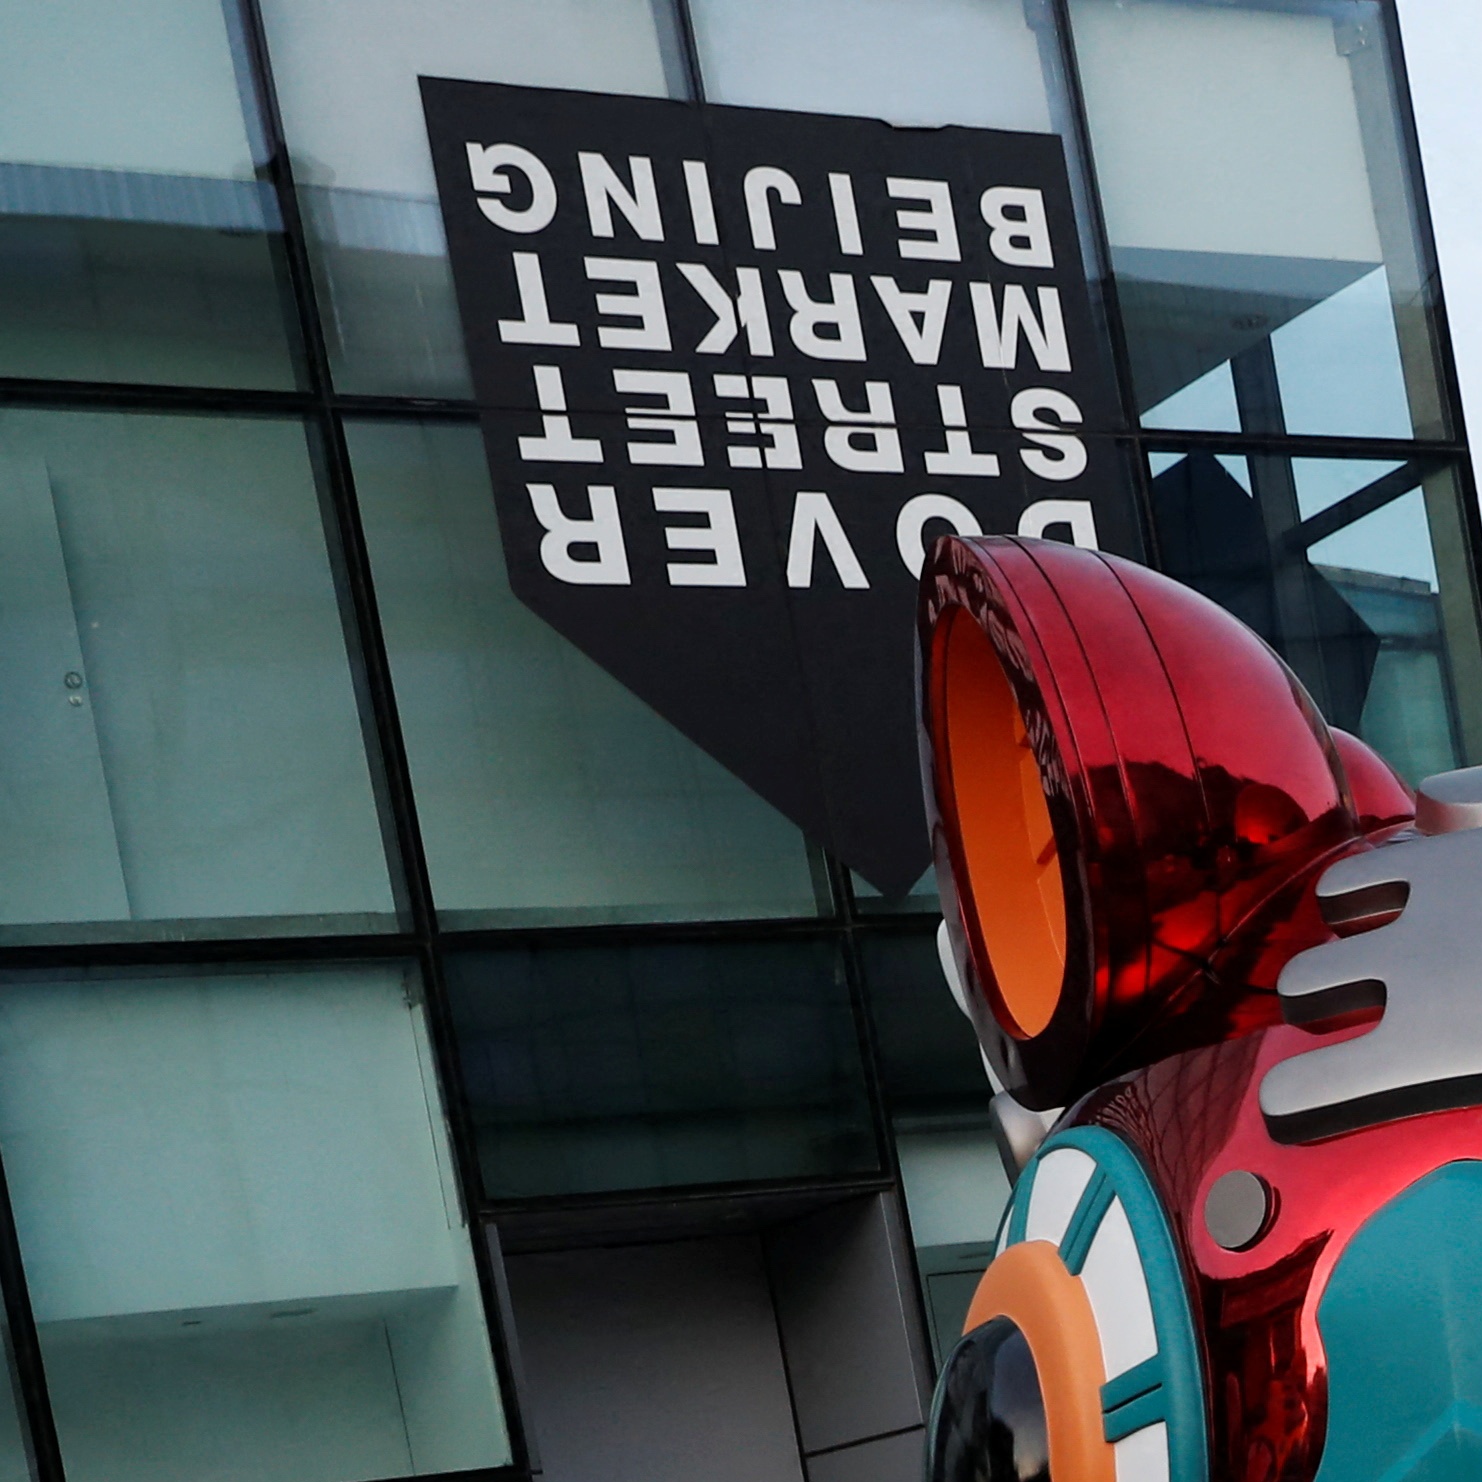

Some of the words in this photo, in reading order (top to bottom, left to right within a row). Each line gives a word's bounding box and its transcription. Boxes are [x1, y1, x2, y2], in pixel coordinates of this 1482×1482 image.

[466, 142, 1054, 268] BEIJING
[498, 252, 1072, 372] MARKET
[518, 365, 1088, 481] STREET
